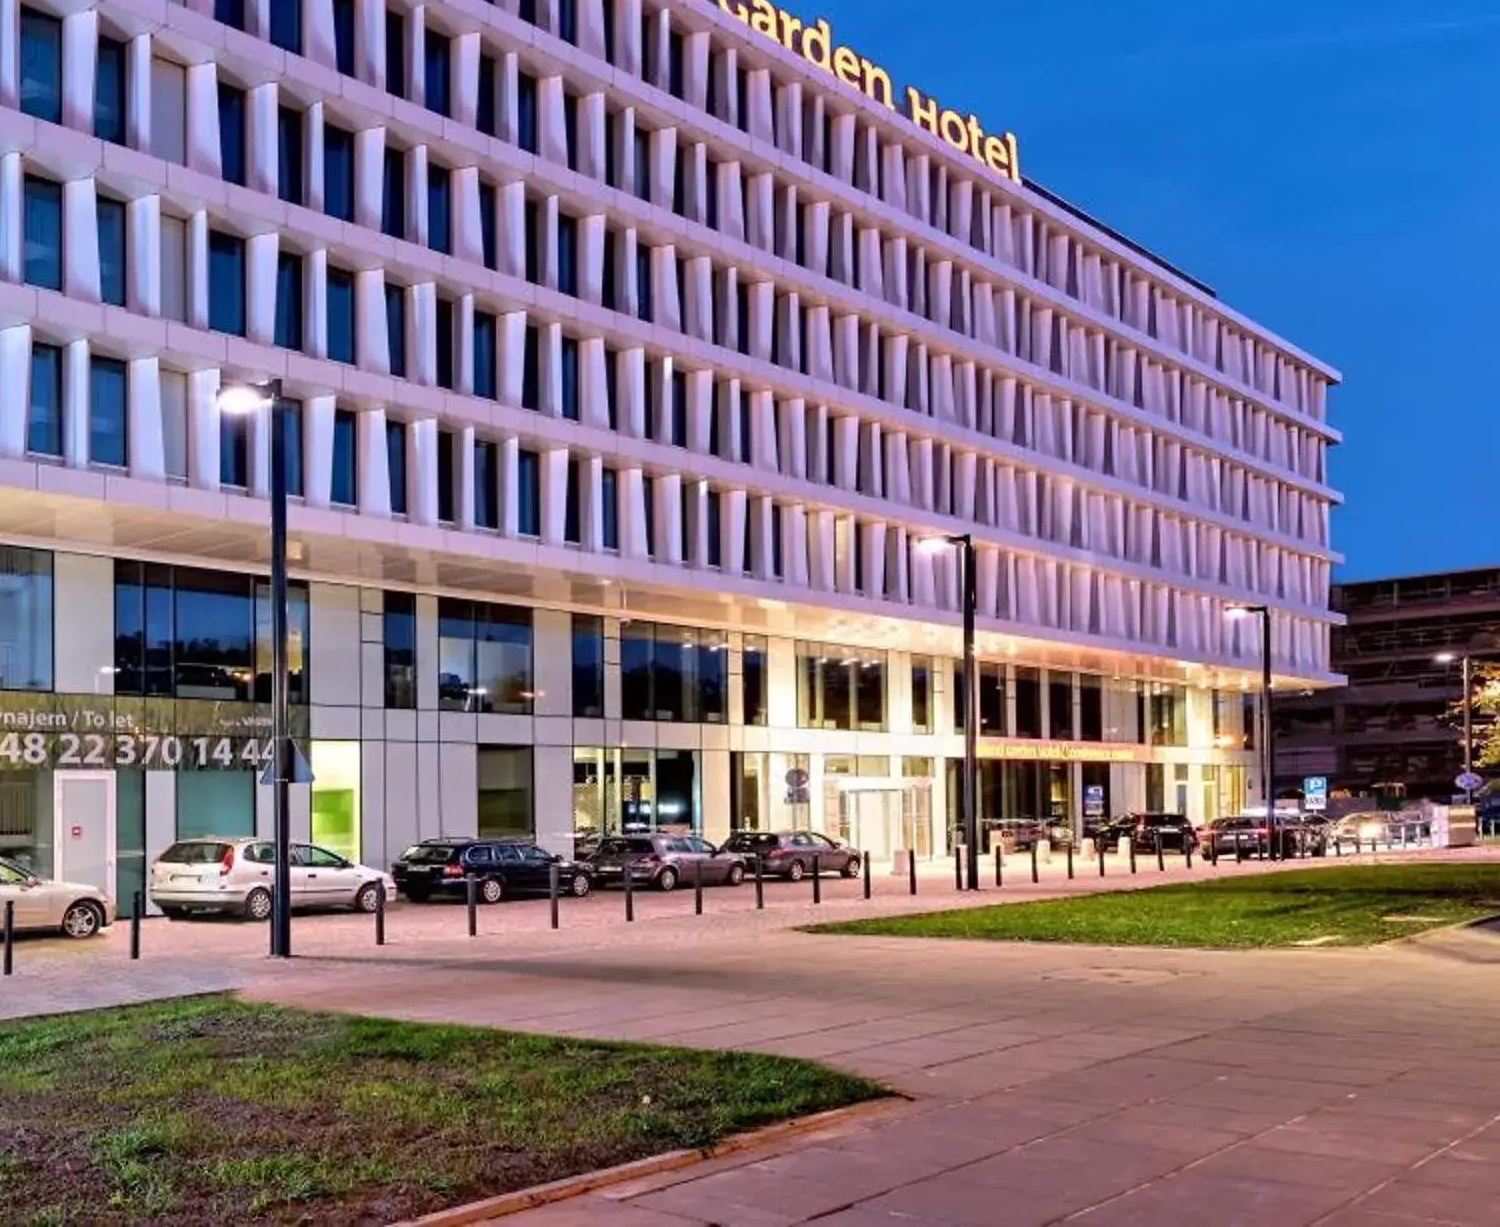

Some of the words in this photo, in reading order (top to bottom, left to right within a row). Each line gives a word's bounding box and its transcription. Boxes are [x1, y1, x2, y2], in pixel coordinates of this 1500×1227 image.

[907, 87, 1022, 185] Hotel
[82, 710, 105, 727] To
[110, 710, 134, 728] let
[58, 733, 105, 765] 22
[115, 735, 183, 765] 370
[193, 737, 233, 766] 14
